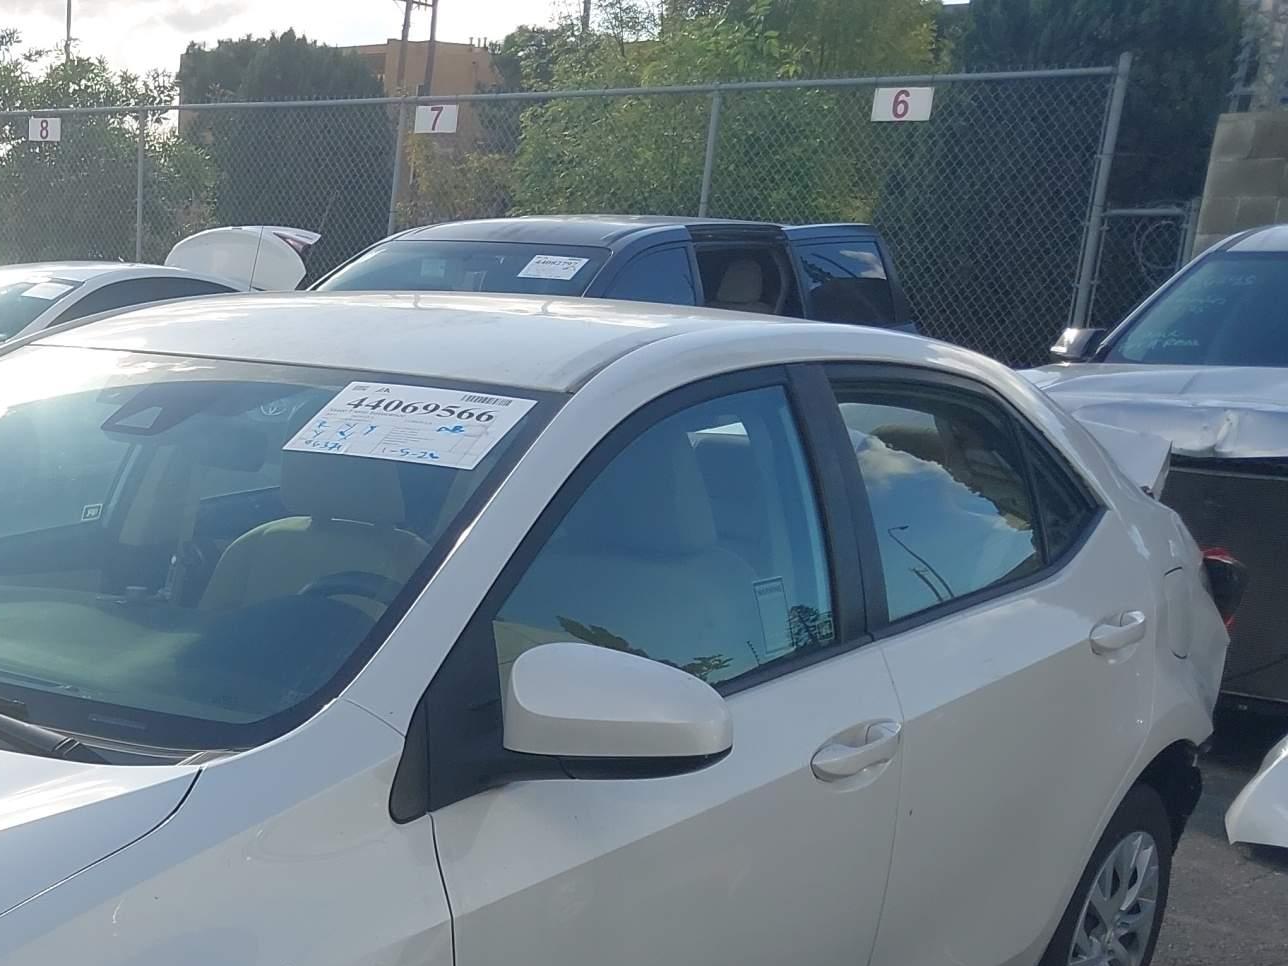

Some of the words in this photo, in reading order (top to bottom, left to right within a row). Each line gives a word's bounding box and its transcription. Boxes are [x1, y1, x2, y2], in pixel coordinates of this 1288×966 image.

[892, 89, 911, 119] 6
[39, 119, 49, 139] 8
[430, 106, 444, 131] 7
[346, 397, 496, 422] 44069566
